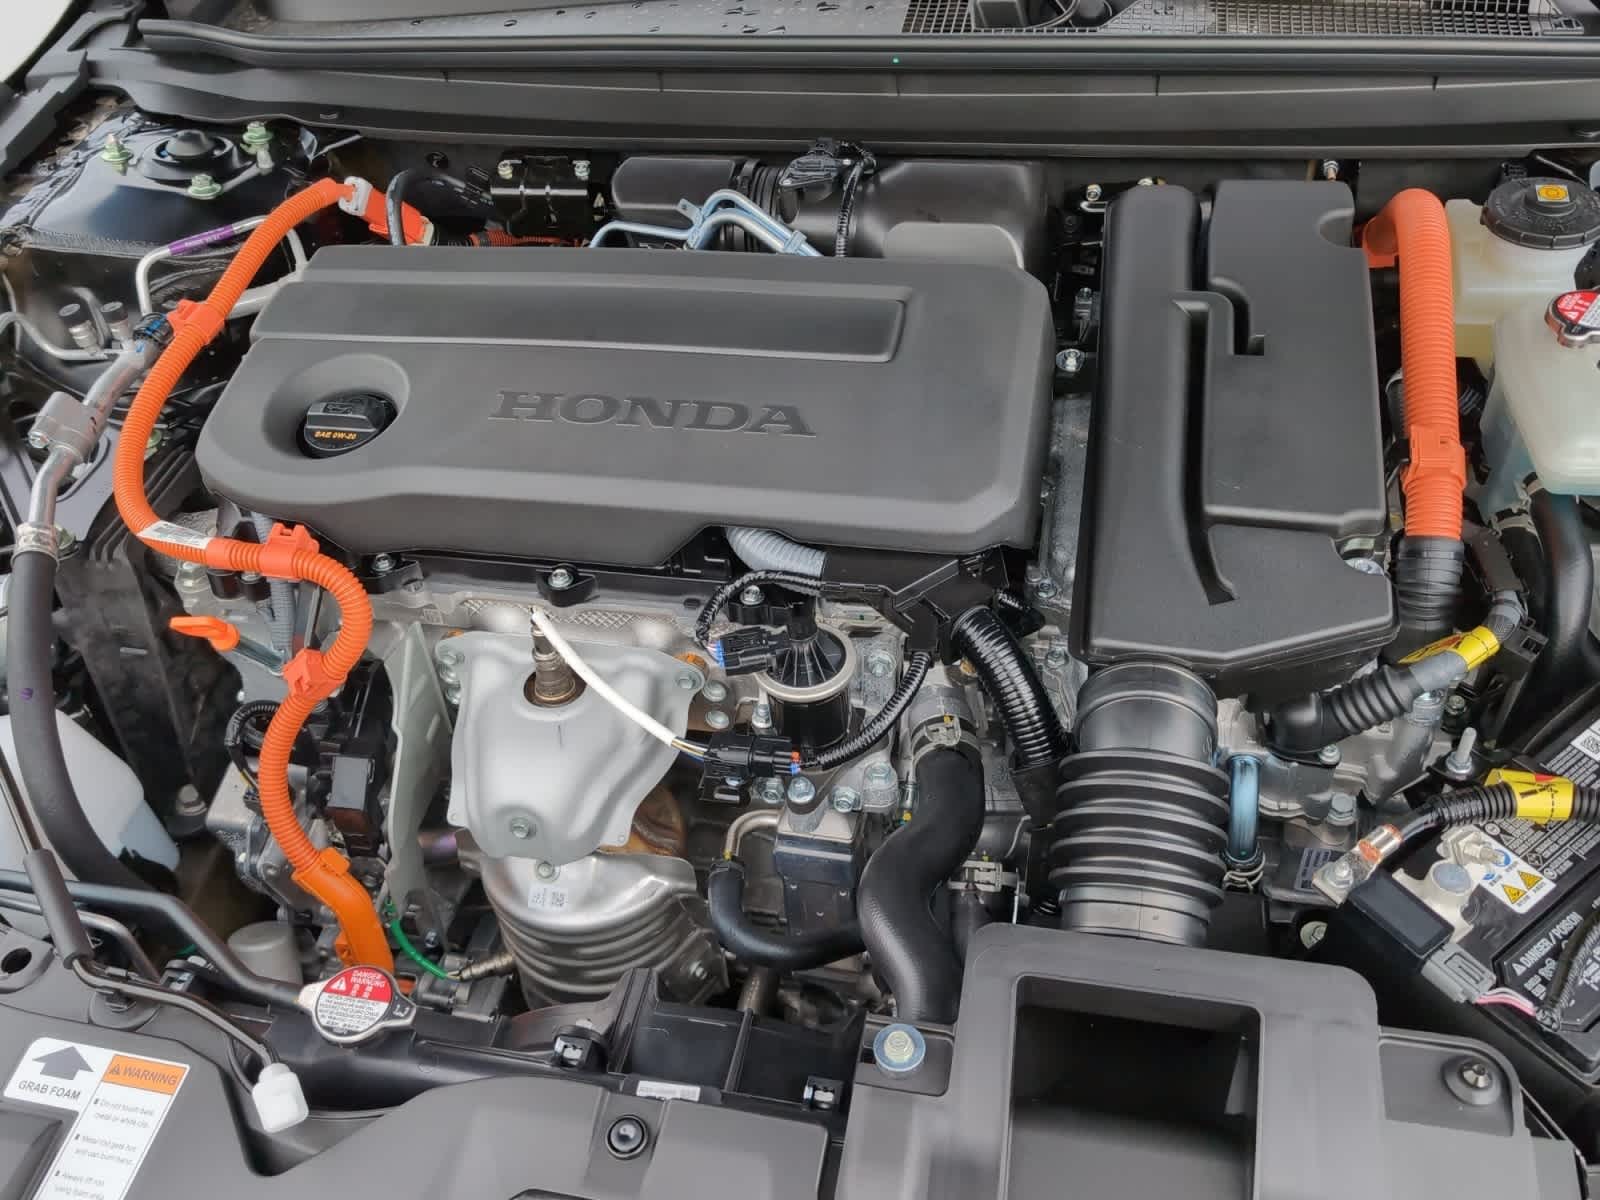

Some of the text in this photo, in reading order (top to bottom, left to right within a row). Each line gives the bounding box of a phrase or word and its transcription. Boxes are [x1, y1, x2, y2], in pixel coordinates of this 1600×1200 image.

[488, 391, 817, 438] HONDA
[123, 1067, 178, 1085] WARNING
[18, 1080, 81, 1101] GRAB FOAM
